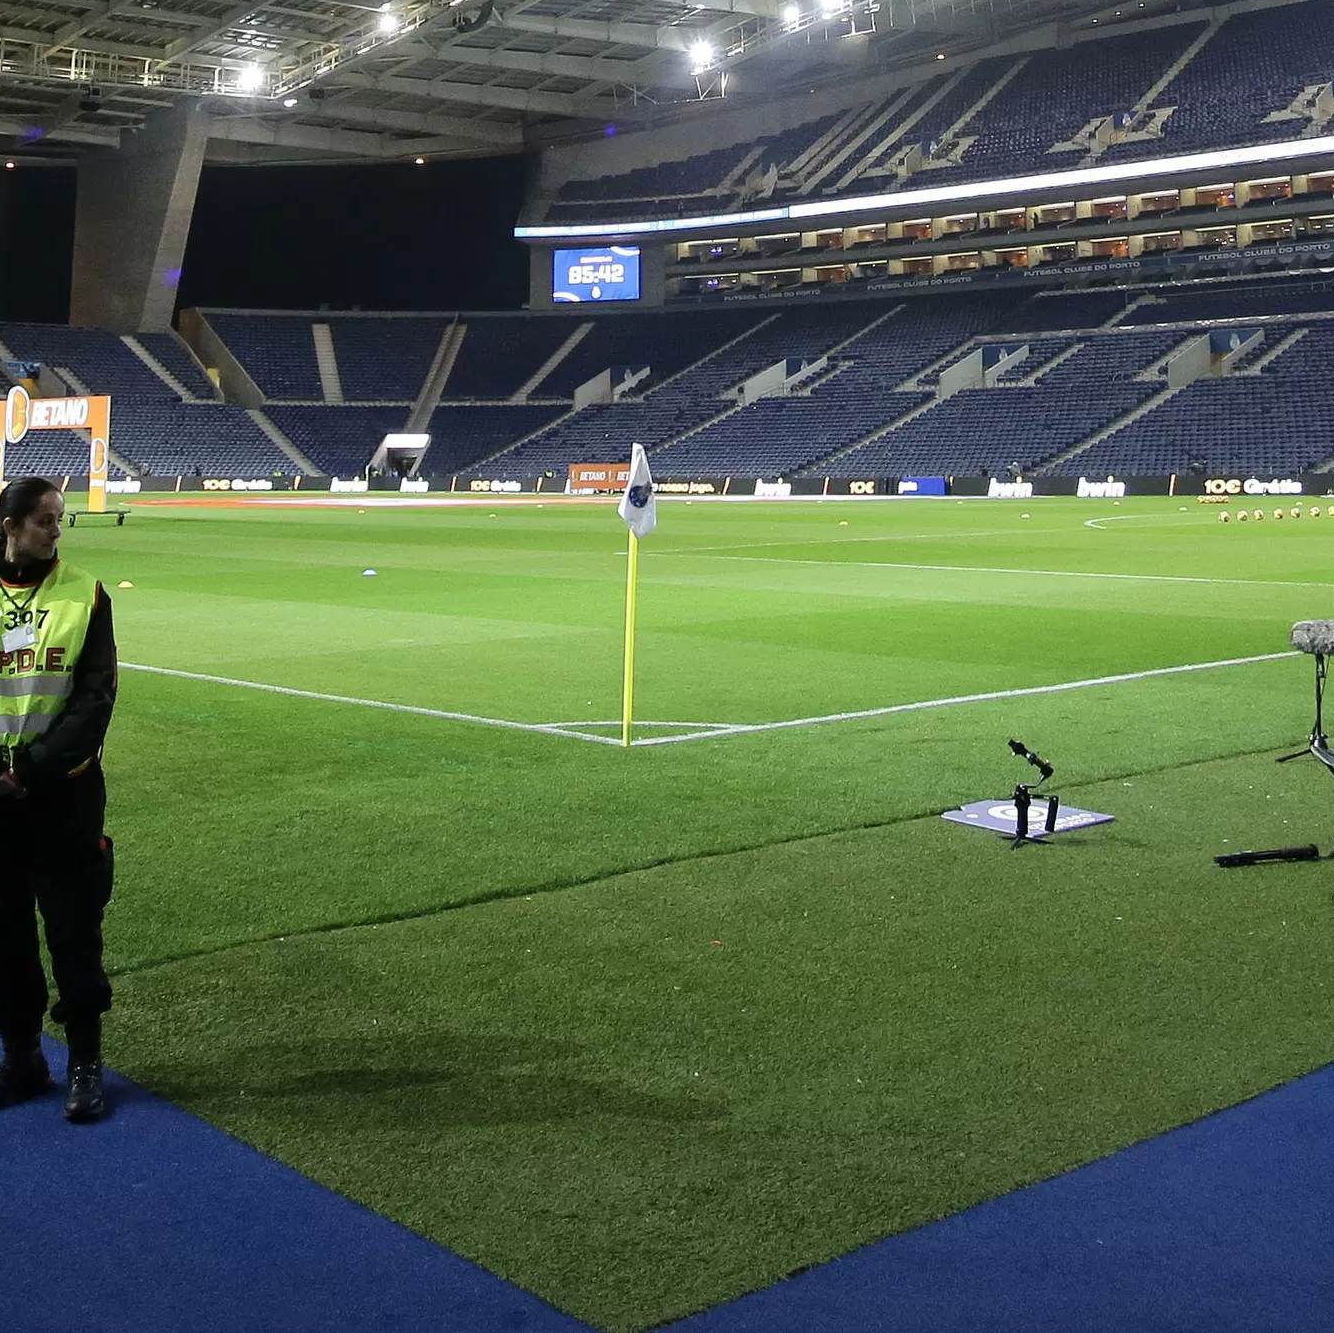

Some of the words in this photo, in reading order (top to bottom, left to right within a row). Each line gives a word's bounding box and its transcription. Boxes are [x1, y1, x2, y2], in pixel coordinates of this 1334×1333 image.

[1198, 252, 1242, 261] FUTEBOL
[1244, 249, 1277, 258] CLUBE
[1295, 243, 1330, 252] PORTO
[31, 398, 89, 427] BETANO
[988, 475, 1033, 497] bwin
[1077, 475, 1126, 497] bwin
[1204, 478, 1240, 494] 10€
